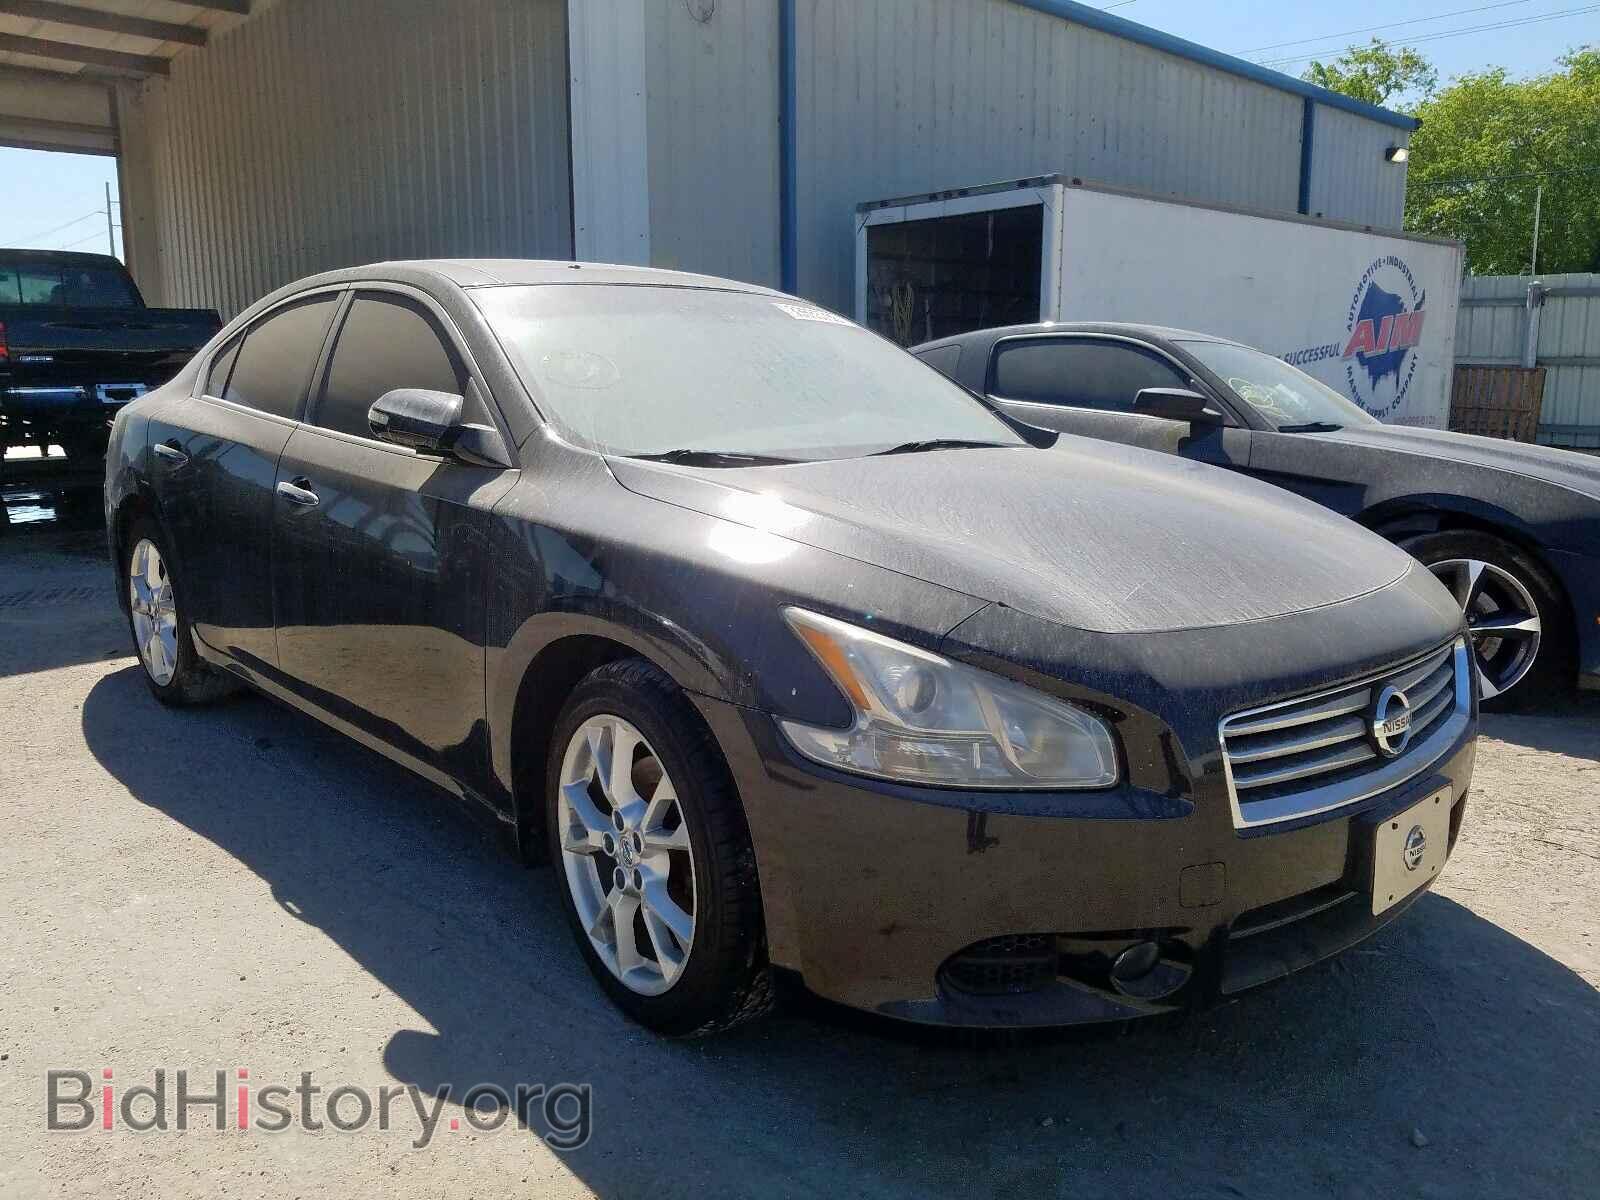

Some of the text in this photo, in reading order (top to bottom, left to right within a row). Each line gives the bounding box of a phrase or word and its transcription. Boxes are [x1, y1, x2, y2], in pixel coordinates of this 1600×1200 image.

[1284, 343, 1340, 366] SUCCESSFUL
[1343, 311, 1426, 358] AIM
[1392, 352, 1418, 409] COMPANY
